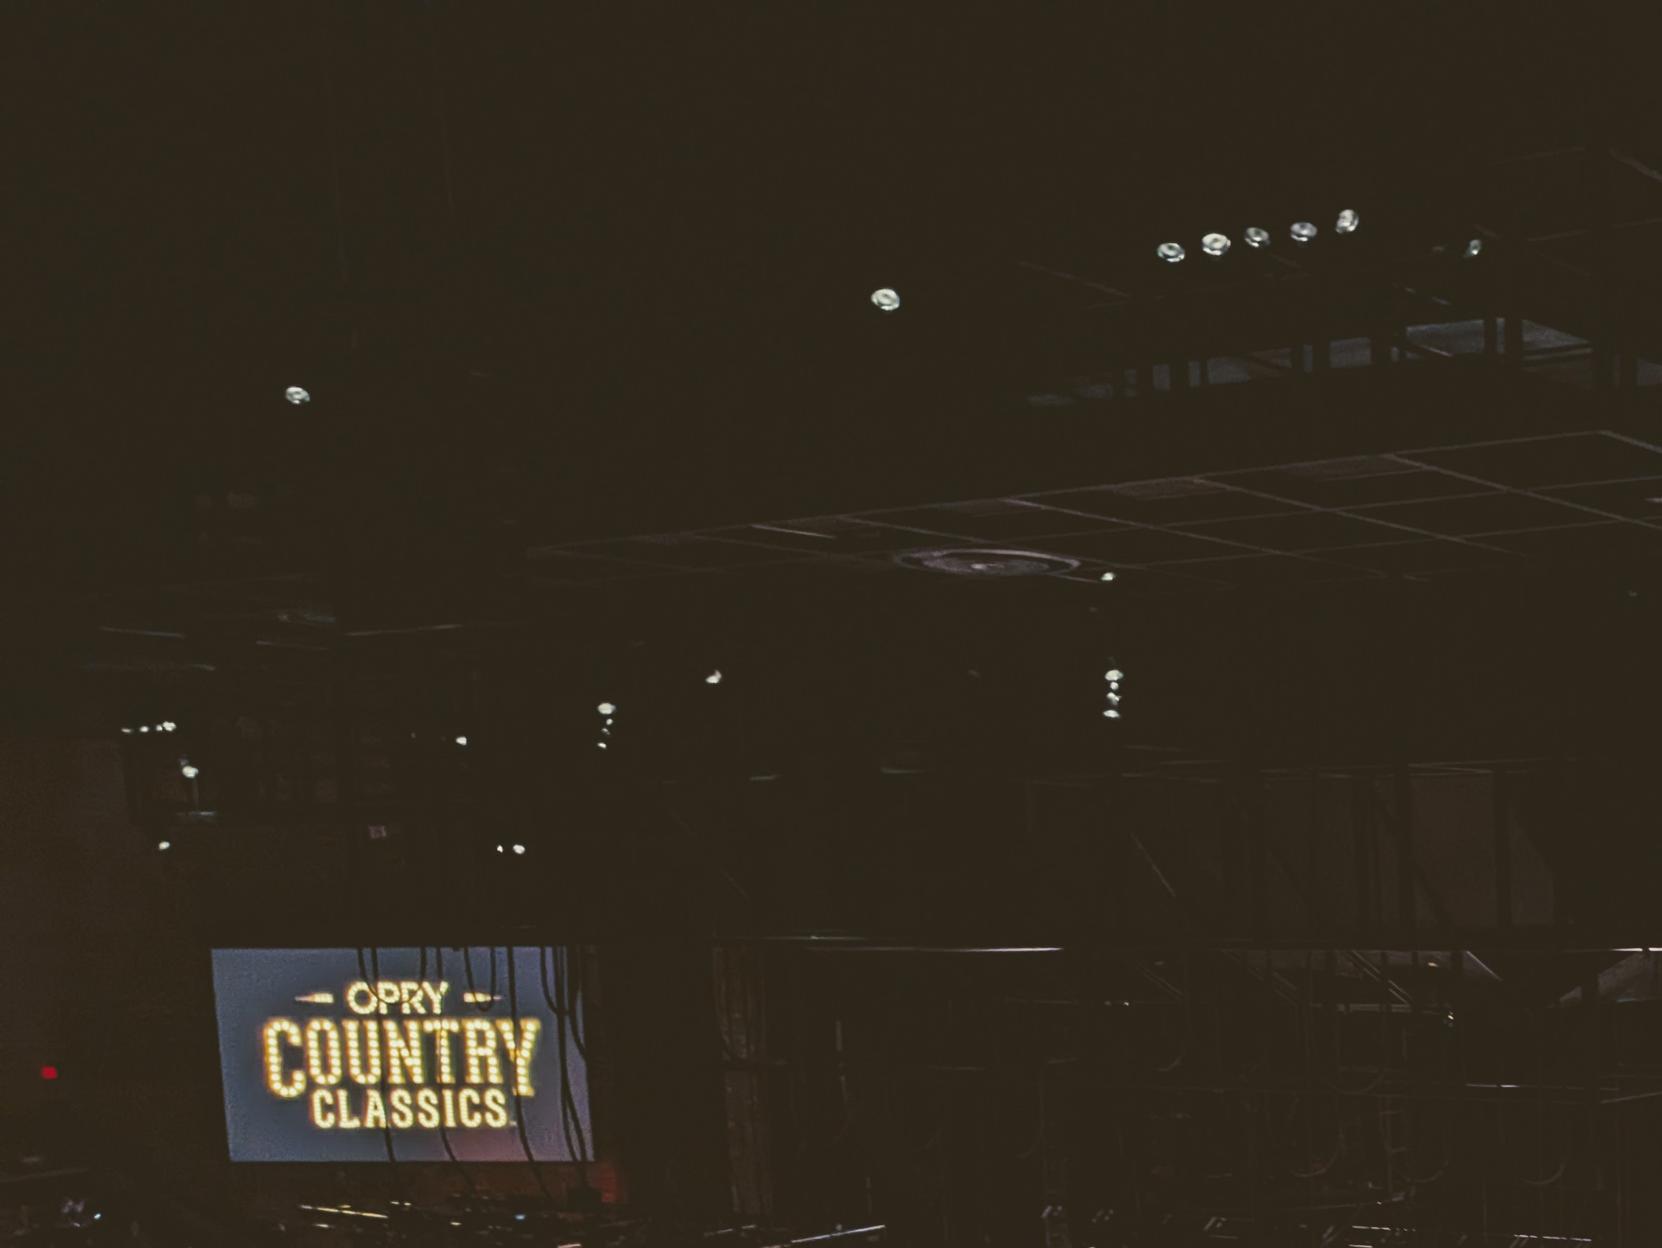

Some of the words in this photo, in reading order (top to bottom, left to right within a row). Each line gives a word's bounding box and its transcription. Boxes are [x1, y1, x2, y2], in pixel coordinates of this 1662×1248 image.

[346, 980, 449, 1015] OPRY
[263, 1017, 541, 1097] COUNTRY
[311, 1089, 509, 1129] CLASSICS
